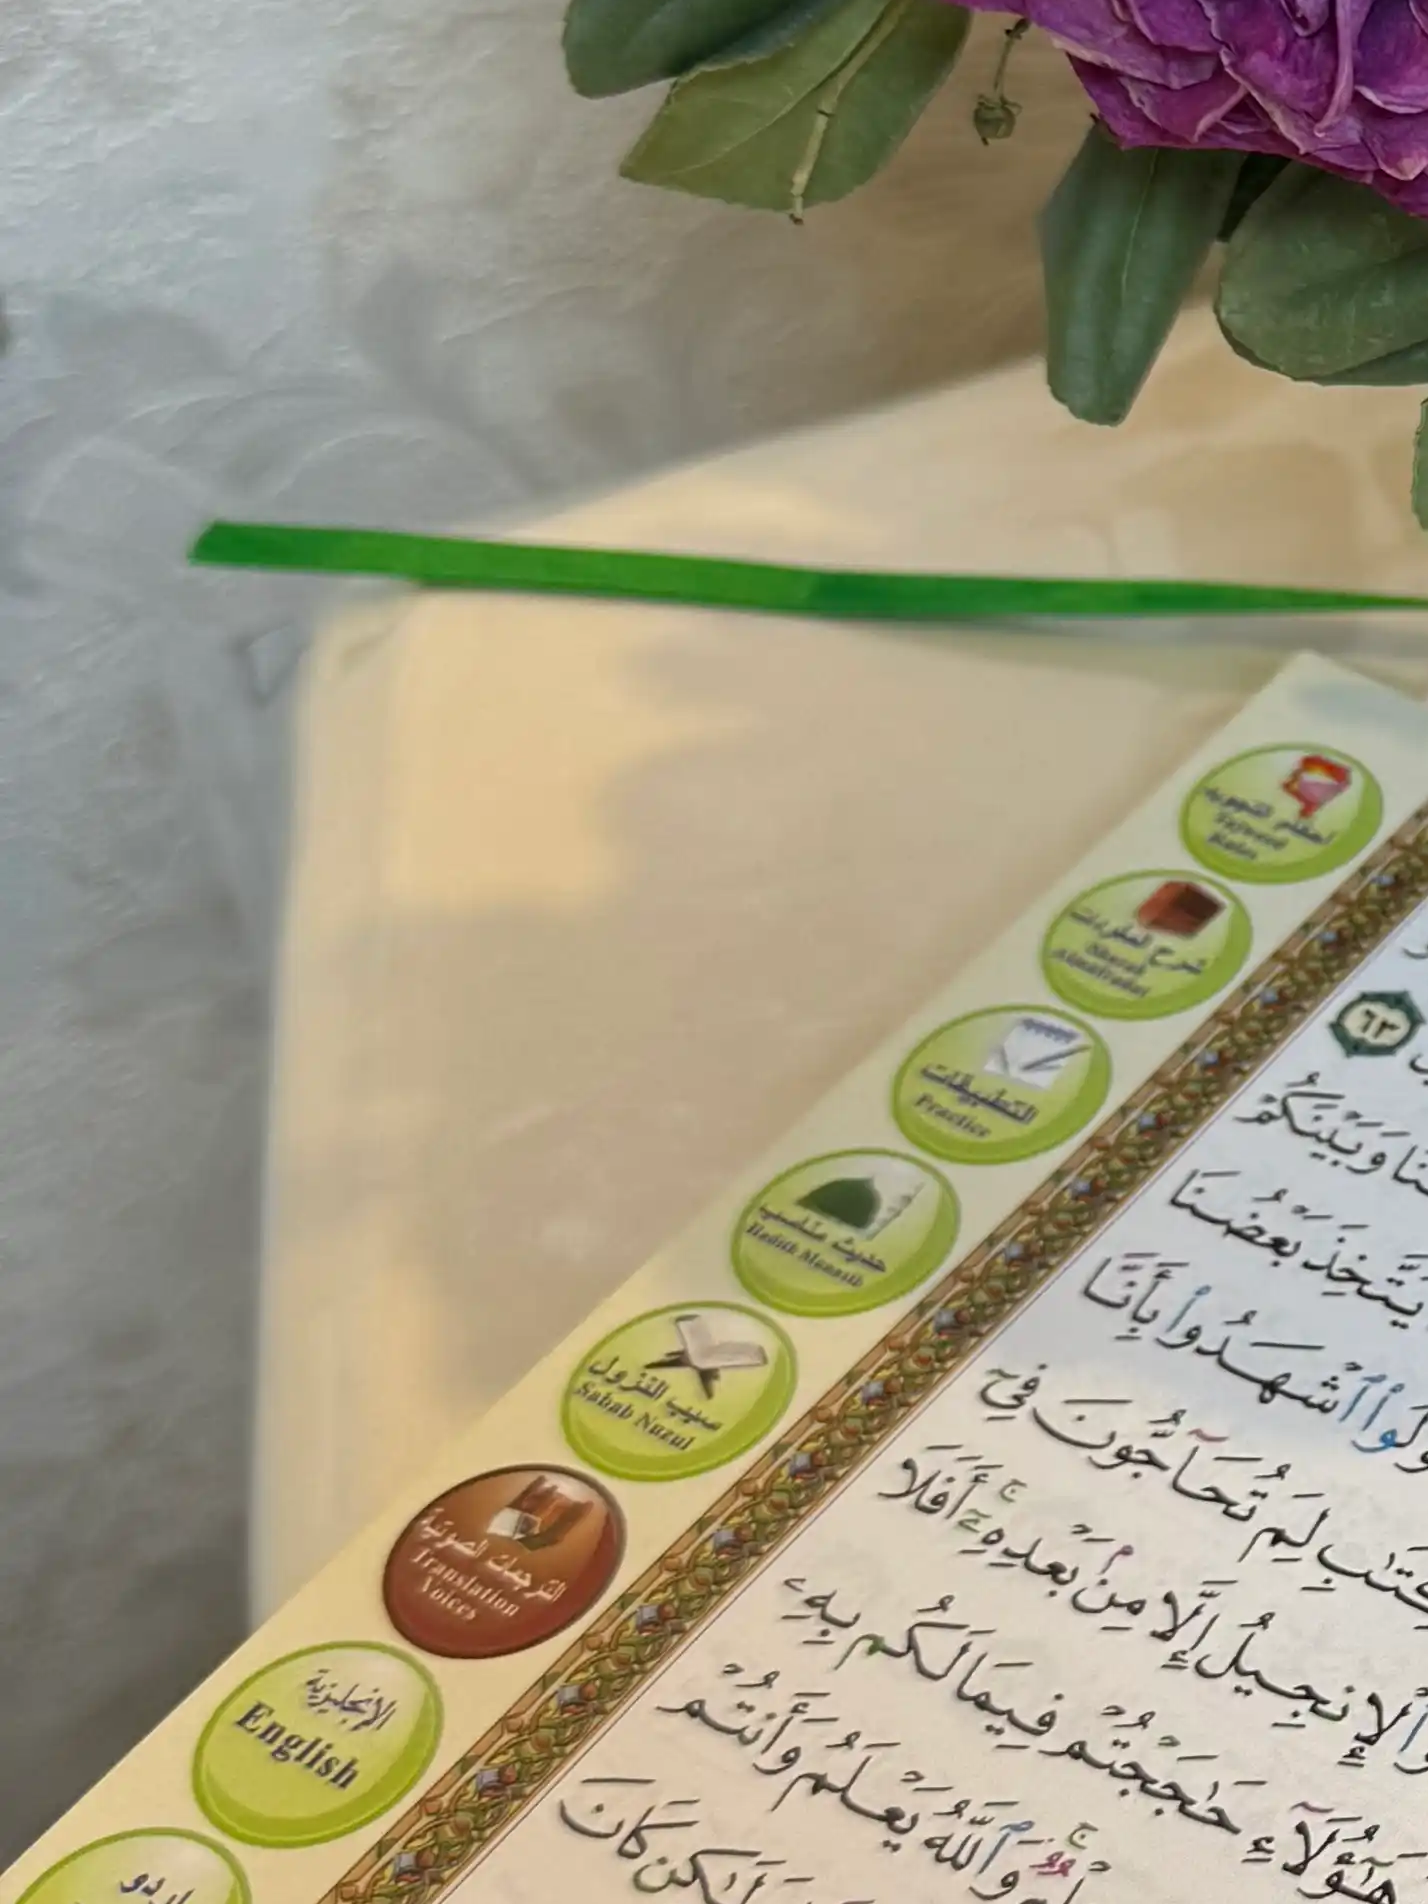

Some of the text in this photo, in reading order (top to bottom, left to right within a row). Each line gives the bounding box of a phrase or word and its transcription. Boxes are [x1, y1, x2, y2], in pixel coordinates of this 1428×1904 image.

[912, 1093, 991, 1140] Practice
[574, 1380, 695, 1452] Sabab Nuzul
[411, 1548, 520, 1617] Translation
[418, 1576, 477, 1622] Voices
[235, 1699, 363, 1792] English
